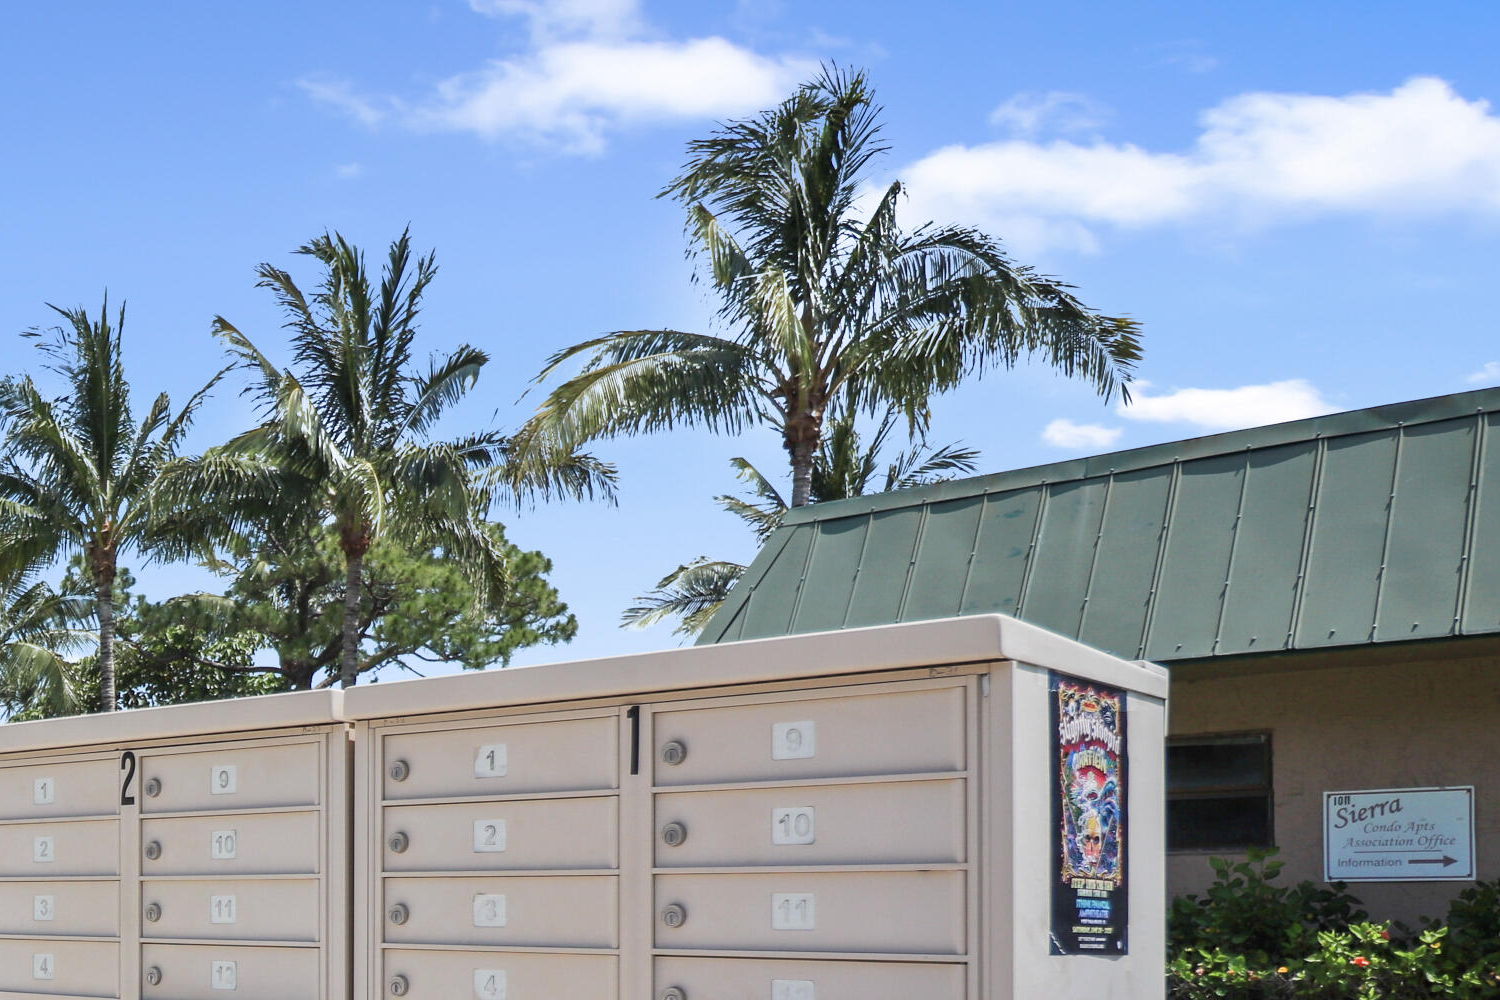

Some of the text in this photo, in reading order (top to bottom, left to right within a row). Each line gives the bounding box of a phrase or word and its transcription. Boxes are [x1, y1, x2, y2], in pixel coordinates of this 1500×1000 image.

[627, 705, 640, 776] 1
[786, 728, 803, 751] 9
[485, 750, 496, 771] 1
[120, 751, 136, 806] 2
[219, 770, 229, 788] 9
[41, 783, 47, 799] 1
[1334, 798, 1403, 829] Sierra
[779, 813, 811, 837] 10
[1364, 821, 1435, 835] Condo Apts
[215, 835, 234, 853] 10
[484, 825, 496, 846] 2
[1342, 834, 1456, 849] Association Office
[40, 841, 48, 857] 2
[1338, 858, 1403, 867] Information
[40, 900, 48, 916] 3
[215, 900, 232, 918] 11
[484, 900, 497, 920] 3
[779, 899, 808, 922] 11
[40, 958, 49, 975] 4
[483, 975, 497, 996] 4
